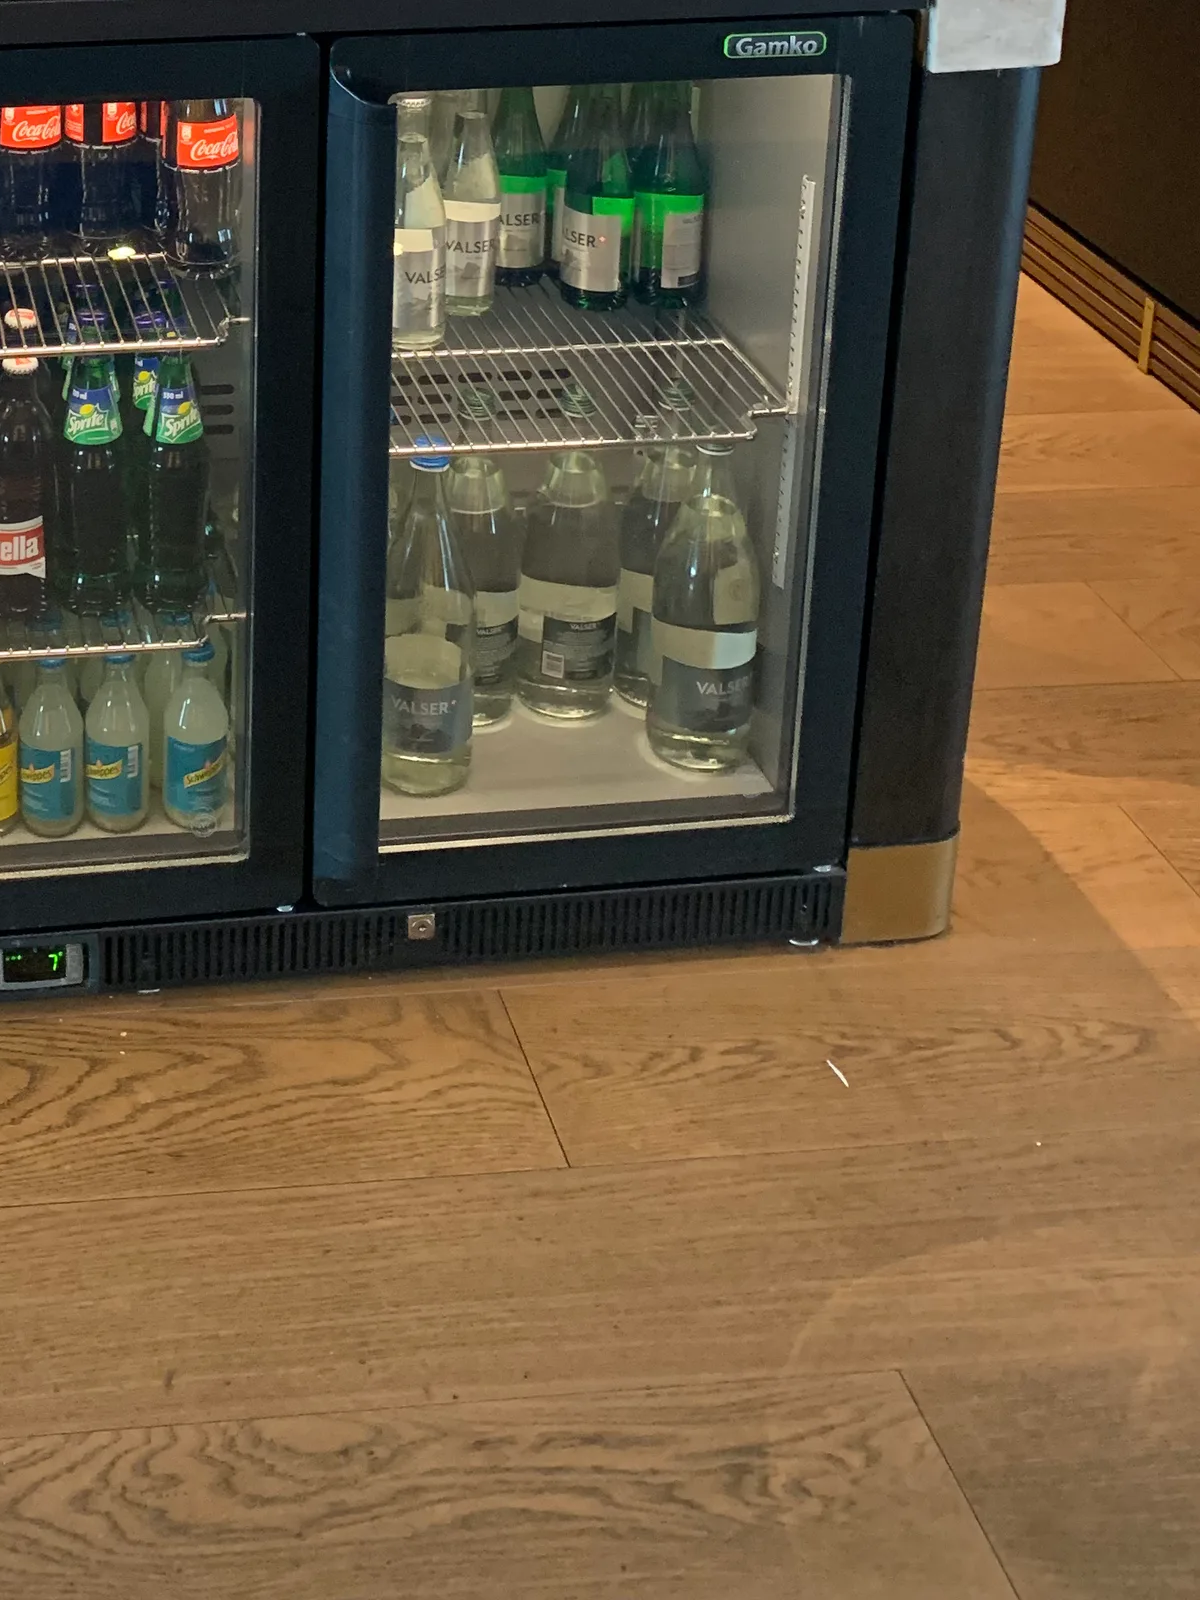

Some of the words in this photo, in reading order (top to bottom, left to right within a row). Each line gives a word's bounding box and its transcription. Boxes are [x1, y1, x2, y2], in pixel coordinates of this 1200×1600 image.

[735, 35, 817, 56] Gamko
[499, 212, 540, 227] ALSER
[563, 228, 596, 248] LSER
[404, 264, 445, 284] VALSE
[68, 413, 104, 434] Sprite
[391, 697, 449, 715] VALSER
